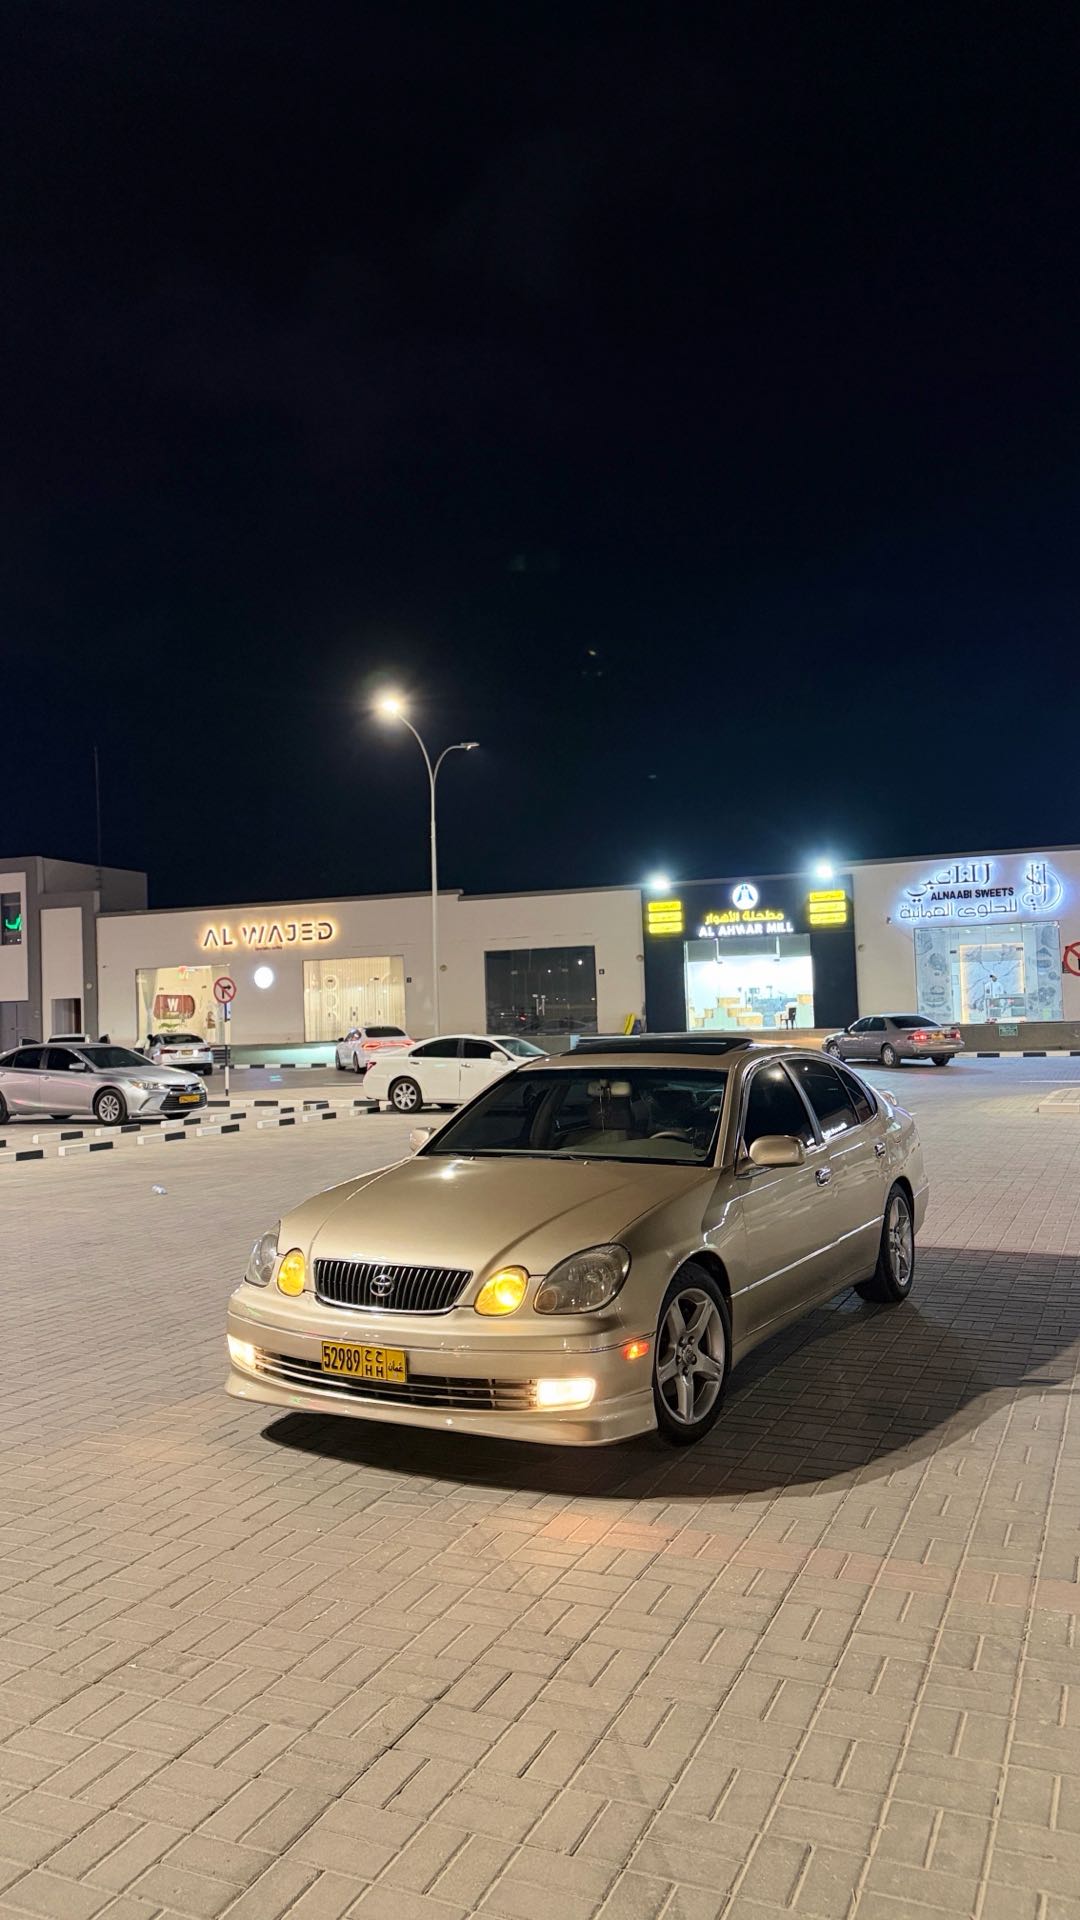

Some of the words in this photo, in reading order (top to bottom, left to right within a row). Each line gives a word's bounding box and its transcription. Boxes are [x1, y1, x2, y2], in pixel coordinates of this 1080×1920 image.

[930, 889, 973, 902] ALNAABI
[974, 886, 1015, 898] SWEETS
[900, 902, 954, 920] العمانية
[957, 898, 1018, 918] للحلوى
[203, 927, 233, 947] AL
[242, 921, 333, 945] WAJED
[698, 925, 715, 938] AL
[717, 923, 763, 936] AHWAR
[766, 921, 794, 933] MILL
[167, 997, 179, 1011] W
[324, 1346, 360, 1372] 52989
